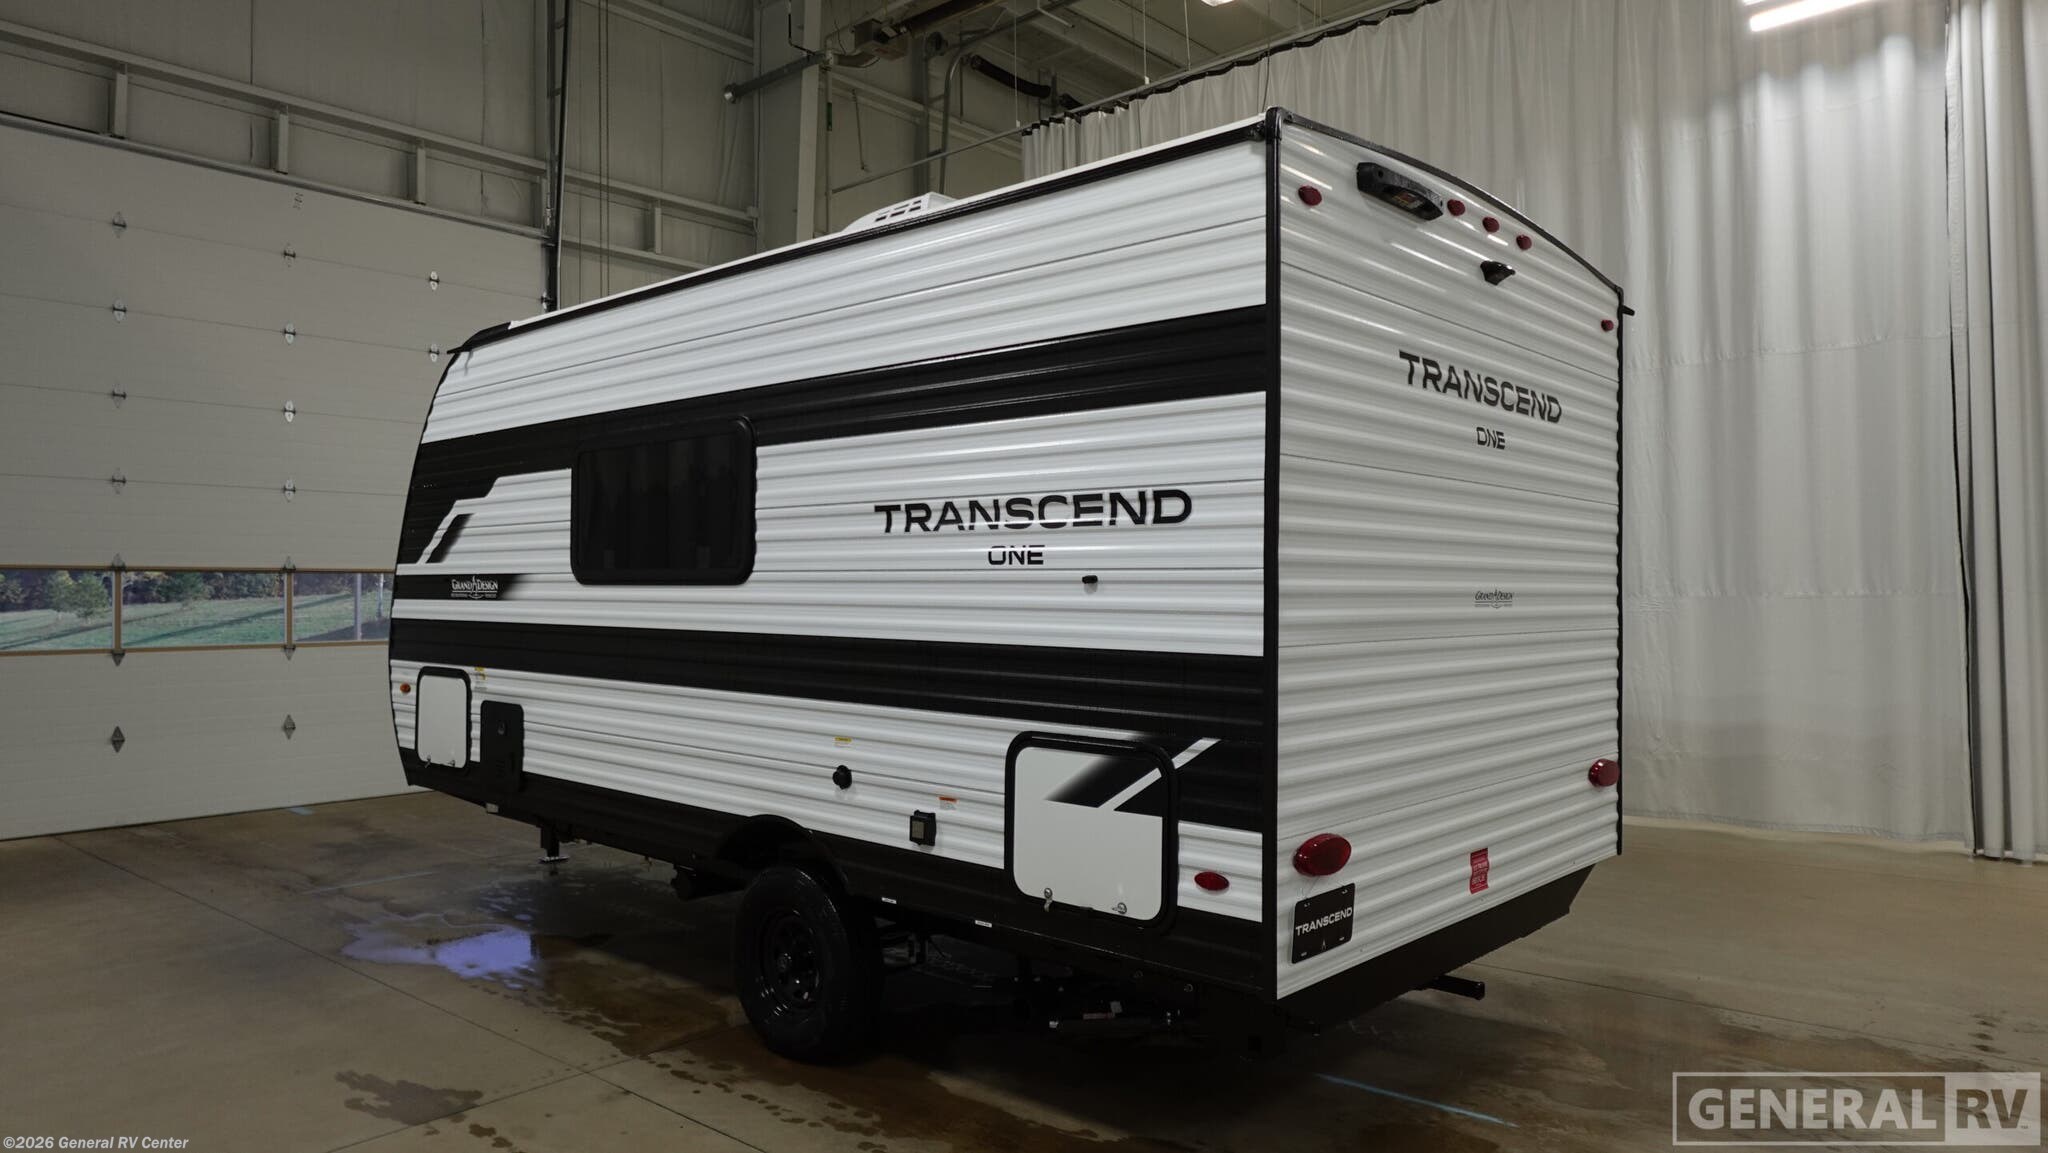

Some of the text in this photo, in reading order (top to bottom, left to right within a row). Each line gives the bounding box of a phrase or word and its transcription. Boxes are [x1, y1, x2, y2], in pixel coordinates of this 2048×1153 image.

[1399, 350, 1562, 423] TRANSCEND
[1476, 426, 1506, 450] ONE
[874, 489, 1193, 533] TRANSCEND
[988, 545, 1045, 565] ONE
[1295, 907, 1353, 936] TRANSCEND
